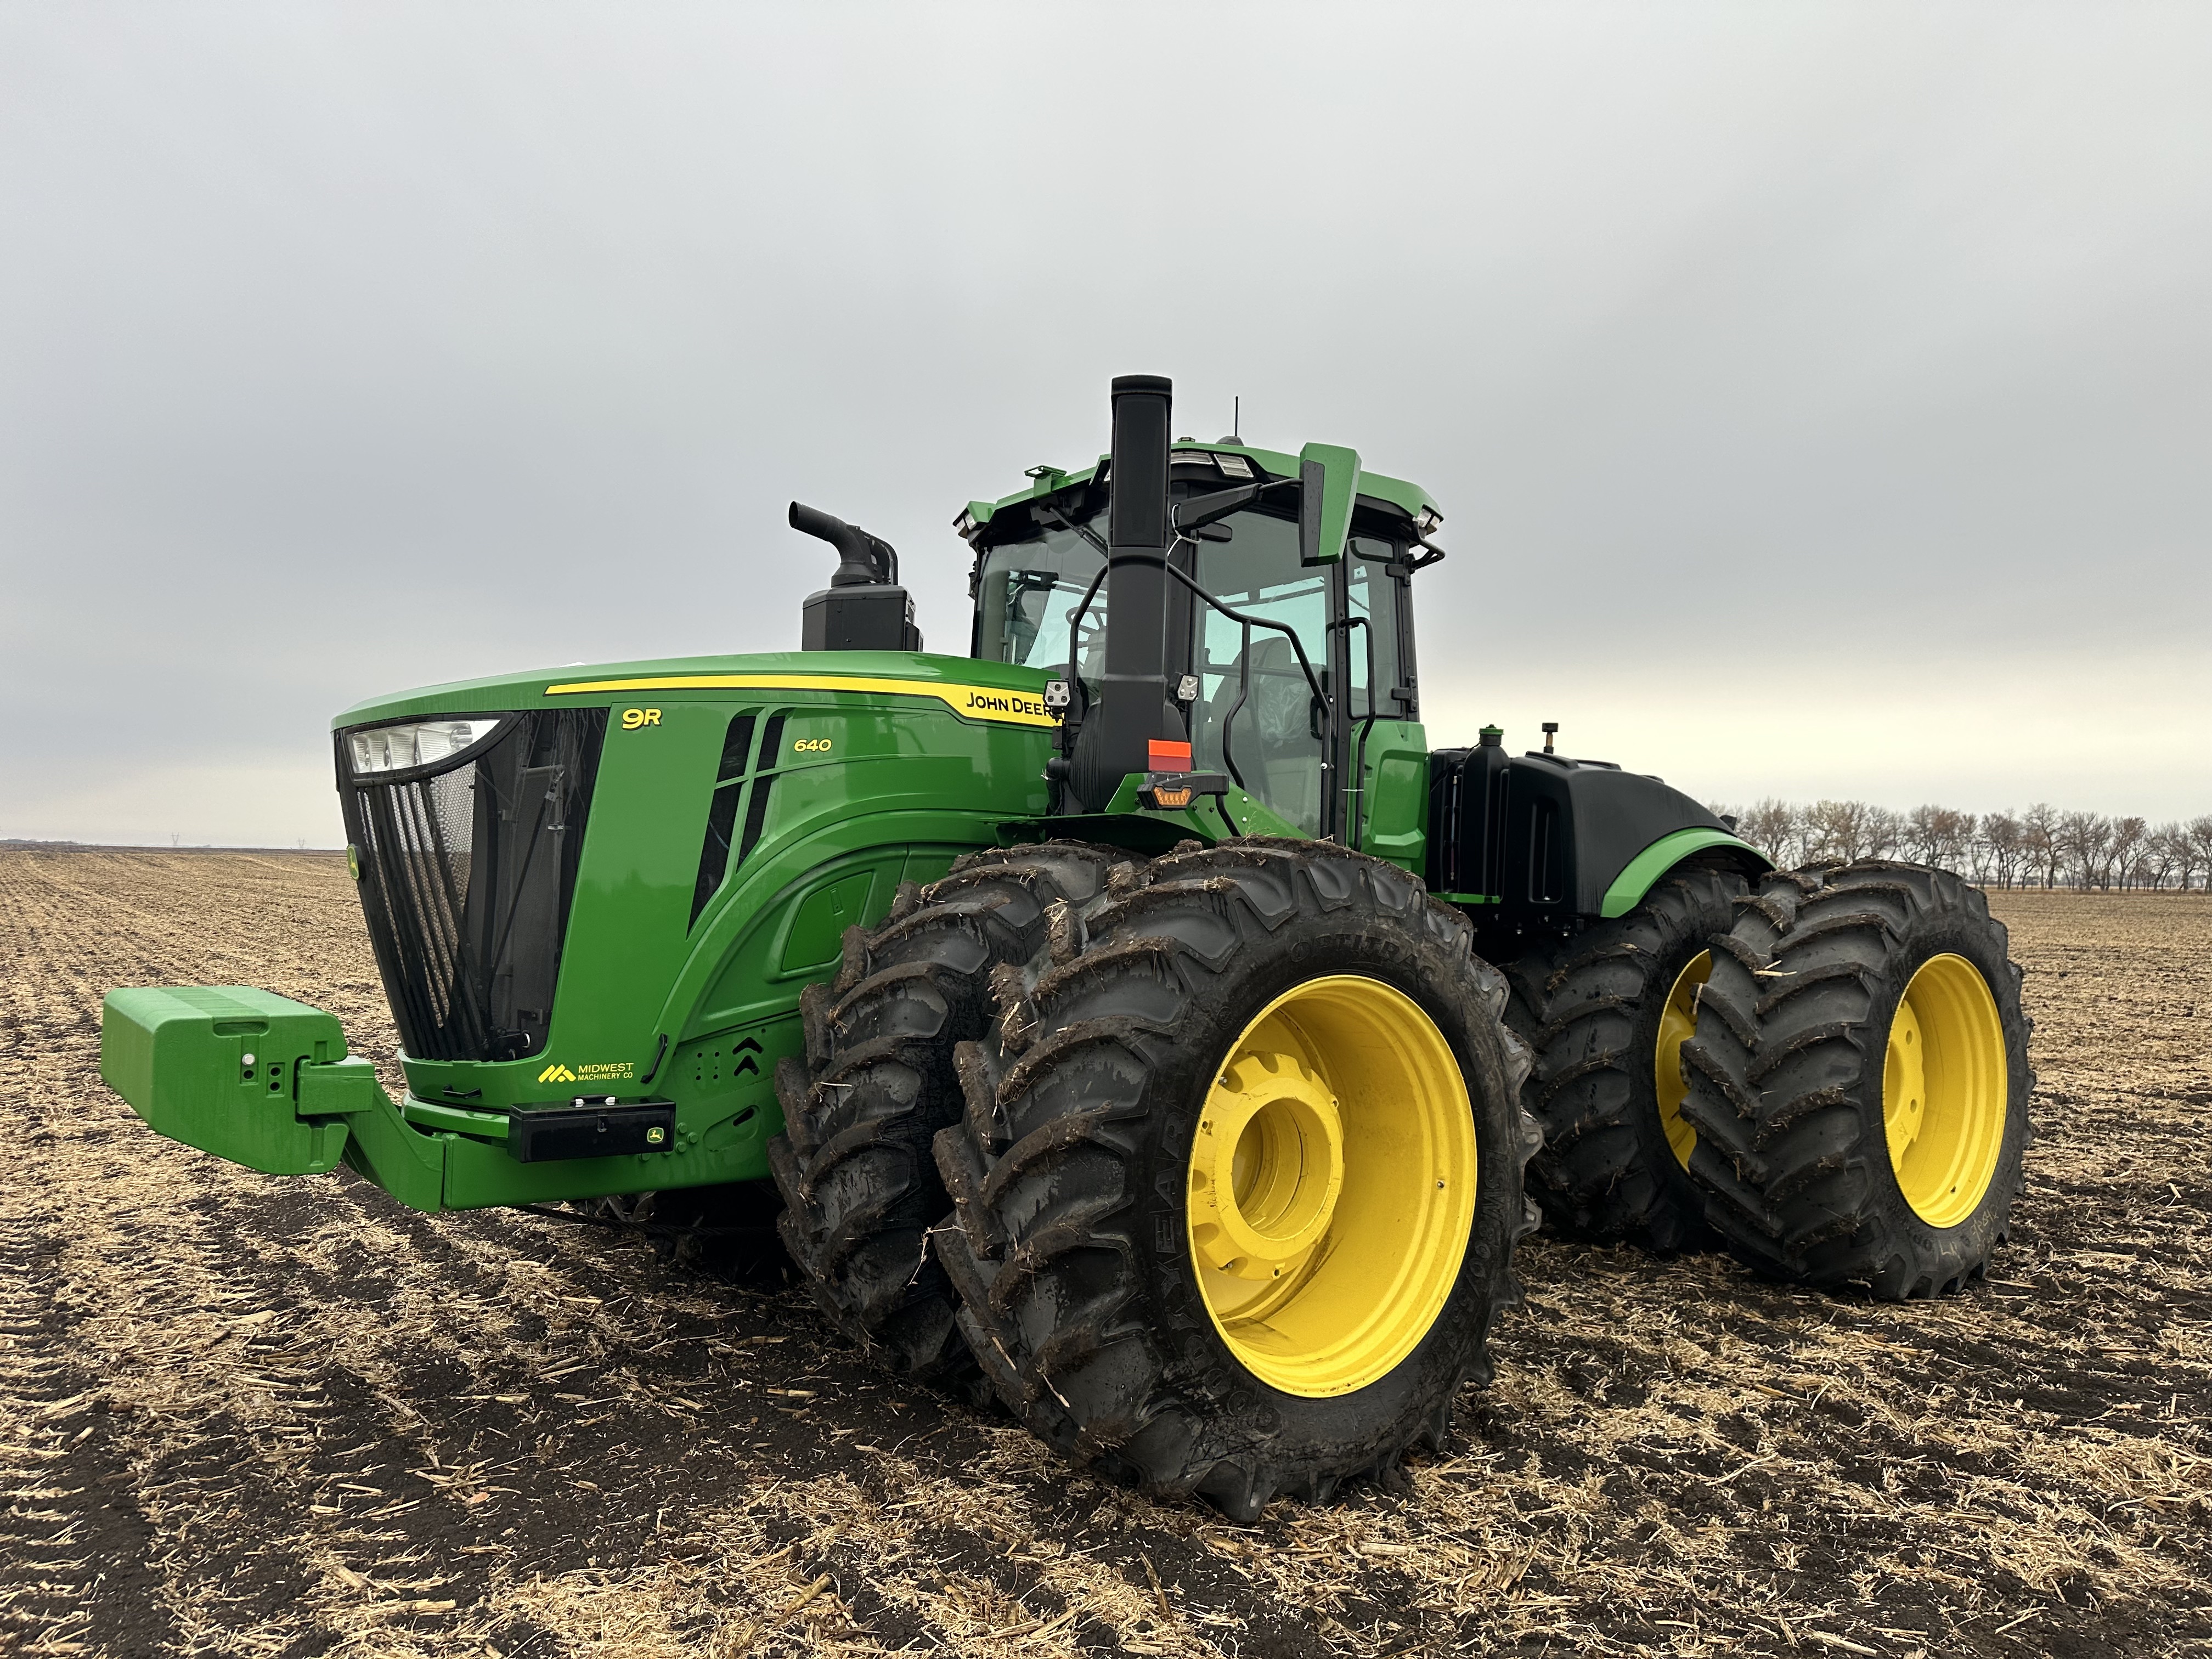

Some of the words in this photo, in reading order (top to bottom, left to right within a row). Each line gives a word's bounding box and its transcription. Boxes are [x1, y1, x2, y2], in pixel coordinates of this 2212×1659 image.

[966, 692, 1009, 712] JOHN
[1012, 697, 1053, 716] DEER
[622, 708, 662, 730] 9R
[793, 738, 832, 752] 640
[578, 1063, 634, 1073] MIDWEST
[578, 1072, 620, 1081] MACHINERY
